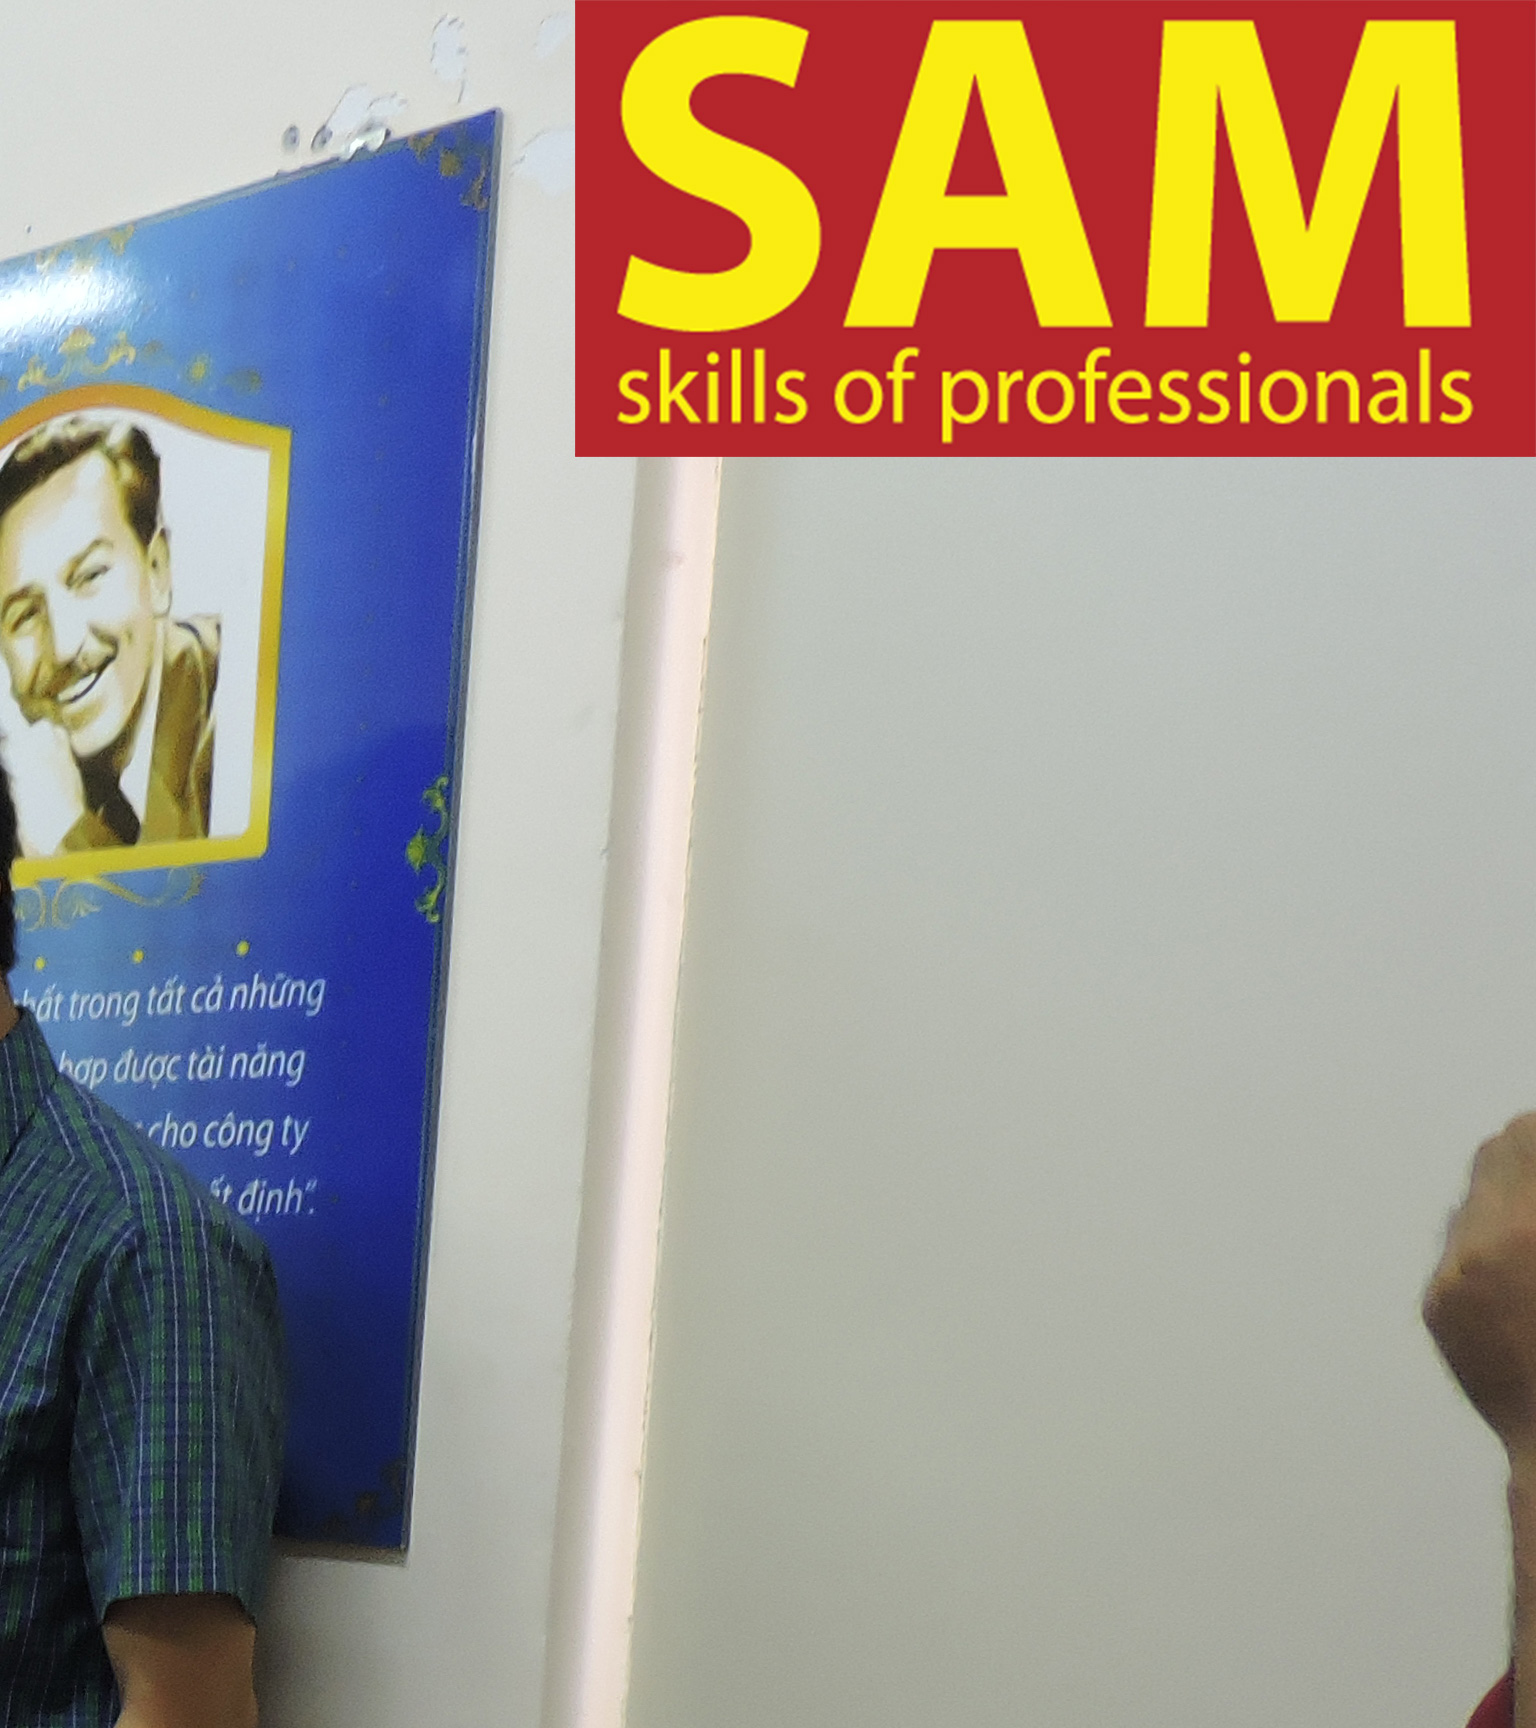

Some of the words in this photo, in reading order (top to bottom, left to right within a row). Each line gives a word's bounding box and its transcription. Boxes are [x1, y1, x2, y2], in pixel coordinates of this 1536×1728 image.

[69, 989, 141, 1028] trong
[146, 974, 186, 1017] tất
[191, 971, 225, 1014] cả
[229, 969, 326, 1018] những
[113, 1047, 182, 1090] được
[188, 1044, 226, 1082] tài
[230, 1041, 306, 1088] năng
[203, 1110, 275, 1158] công
[281, 1113, 311, 1156] ty
